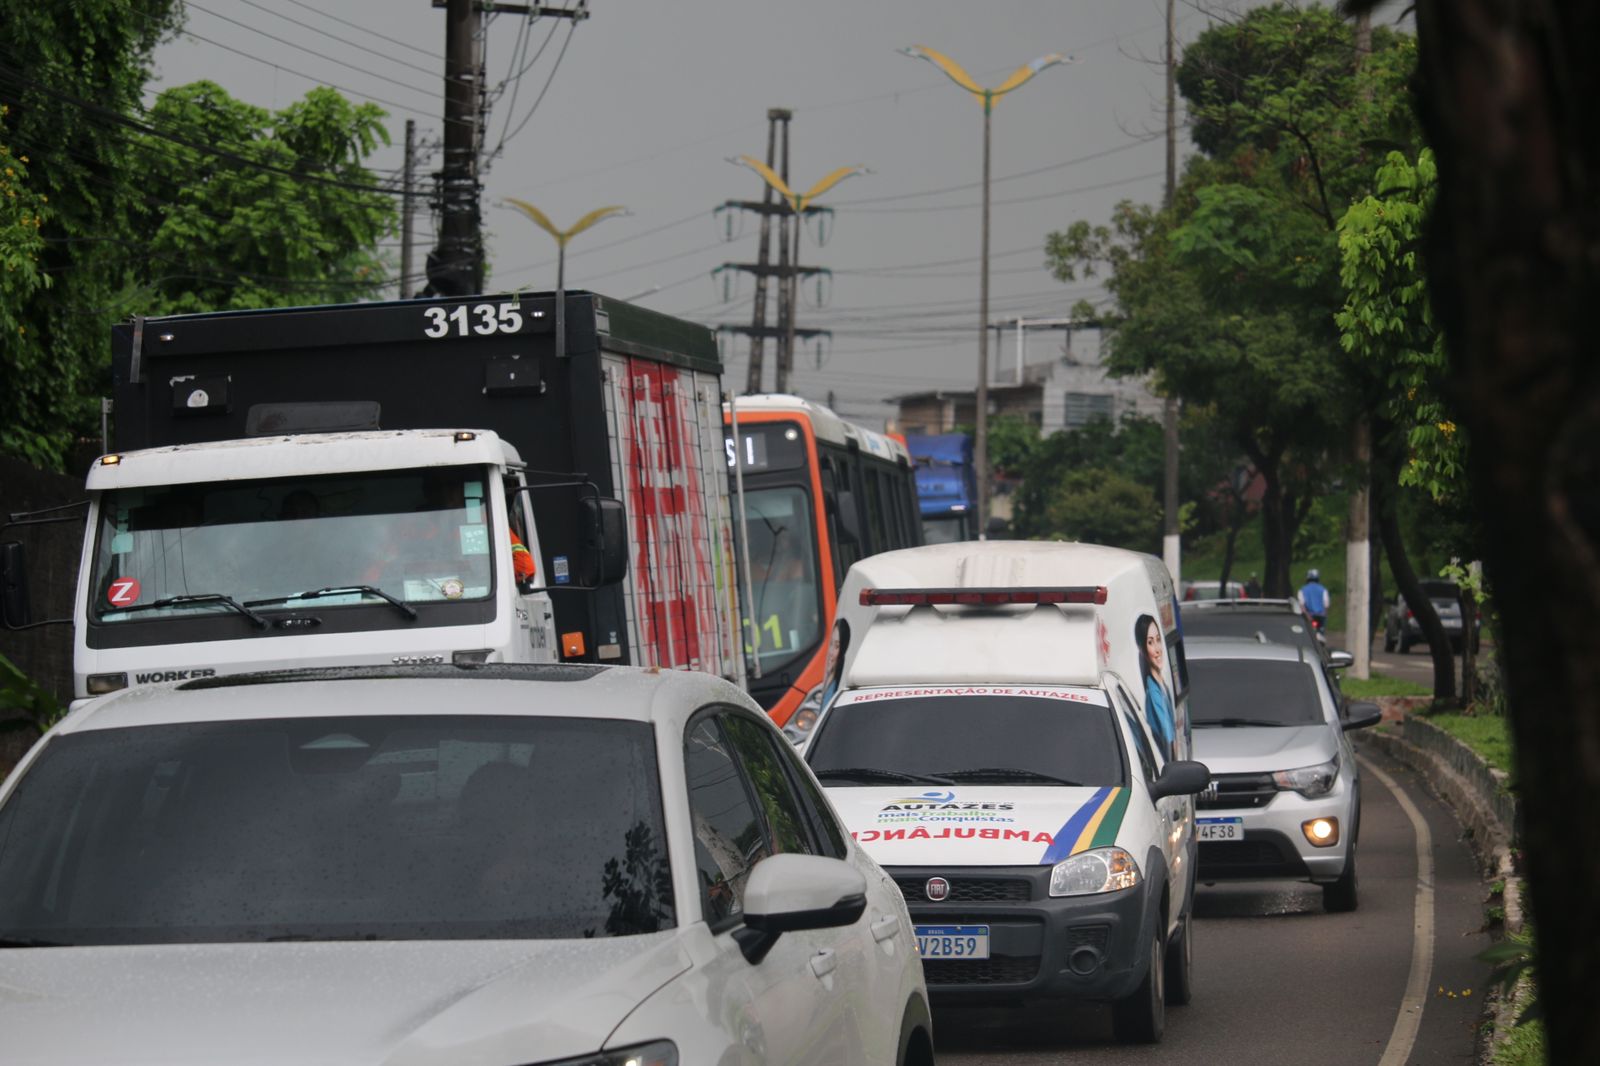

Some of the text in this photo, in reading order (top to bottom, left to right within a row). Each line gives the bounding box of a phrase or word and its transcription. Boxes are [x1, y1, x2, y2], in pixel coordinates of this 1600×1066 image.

[424, 302, 523, 338] 3135
[111, 582, 134, 602] Z
[136, 668, 216, 684] WORKER
[854, 687, 988, 702] REPRESENTAÇÃO
[1018, 689, 1089, 702] AUTAZES
[882, 803, 1014, 811] AUTAZES
[930, 884, 945, 895] FIAT
